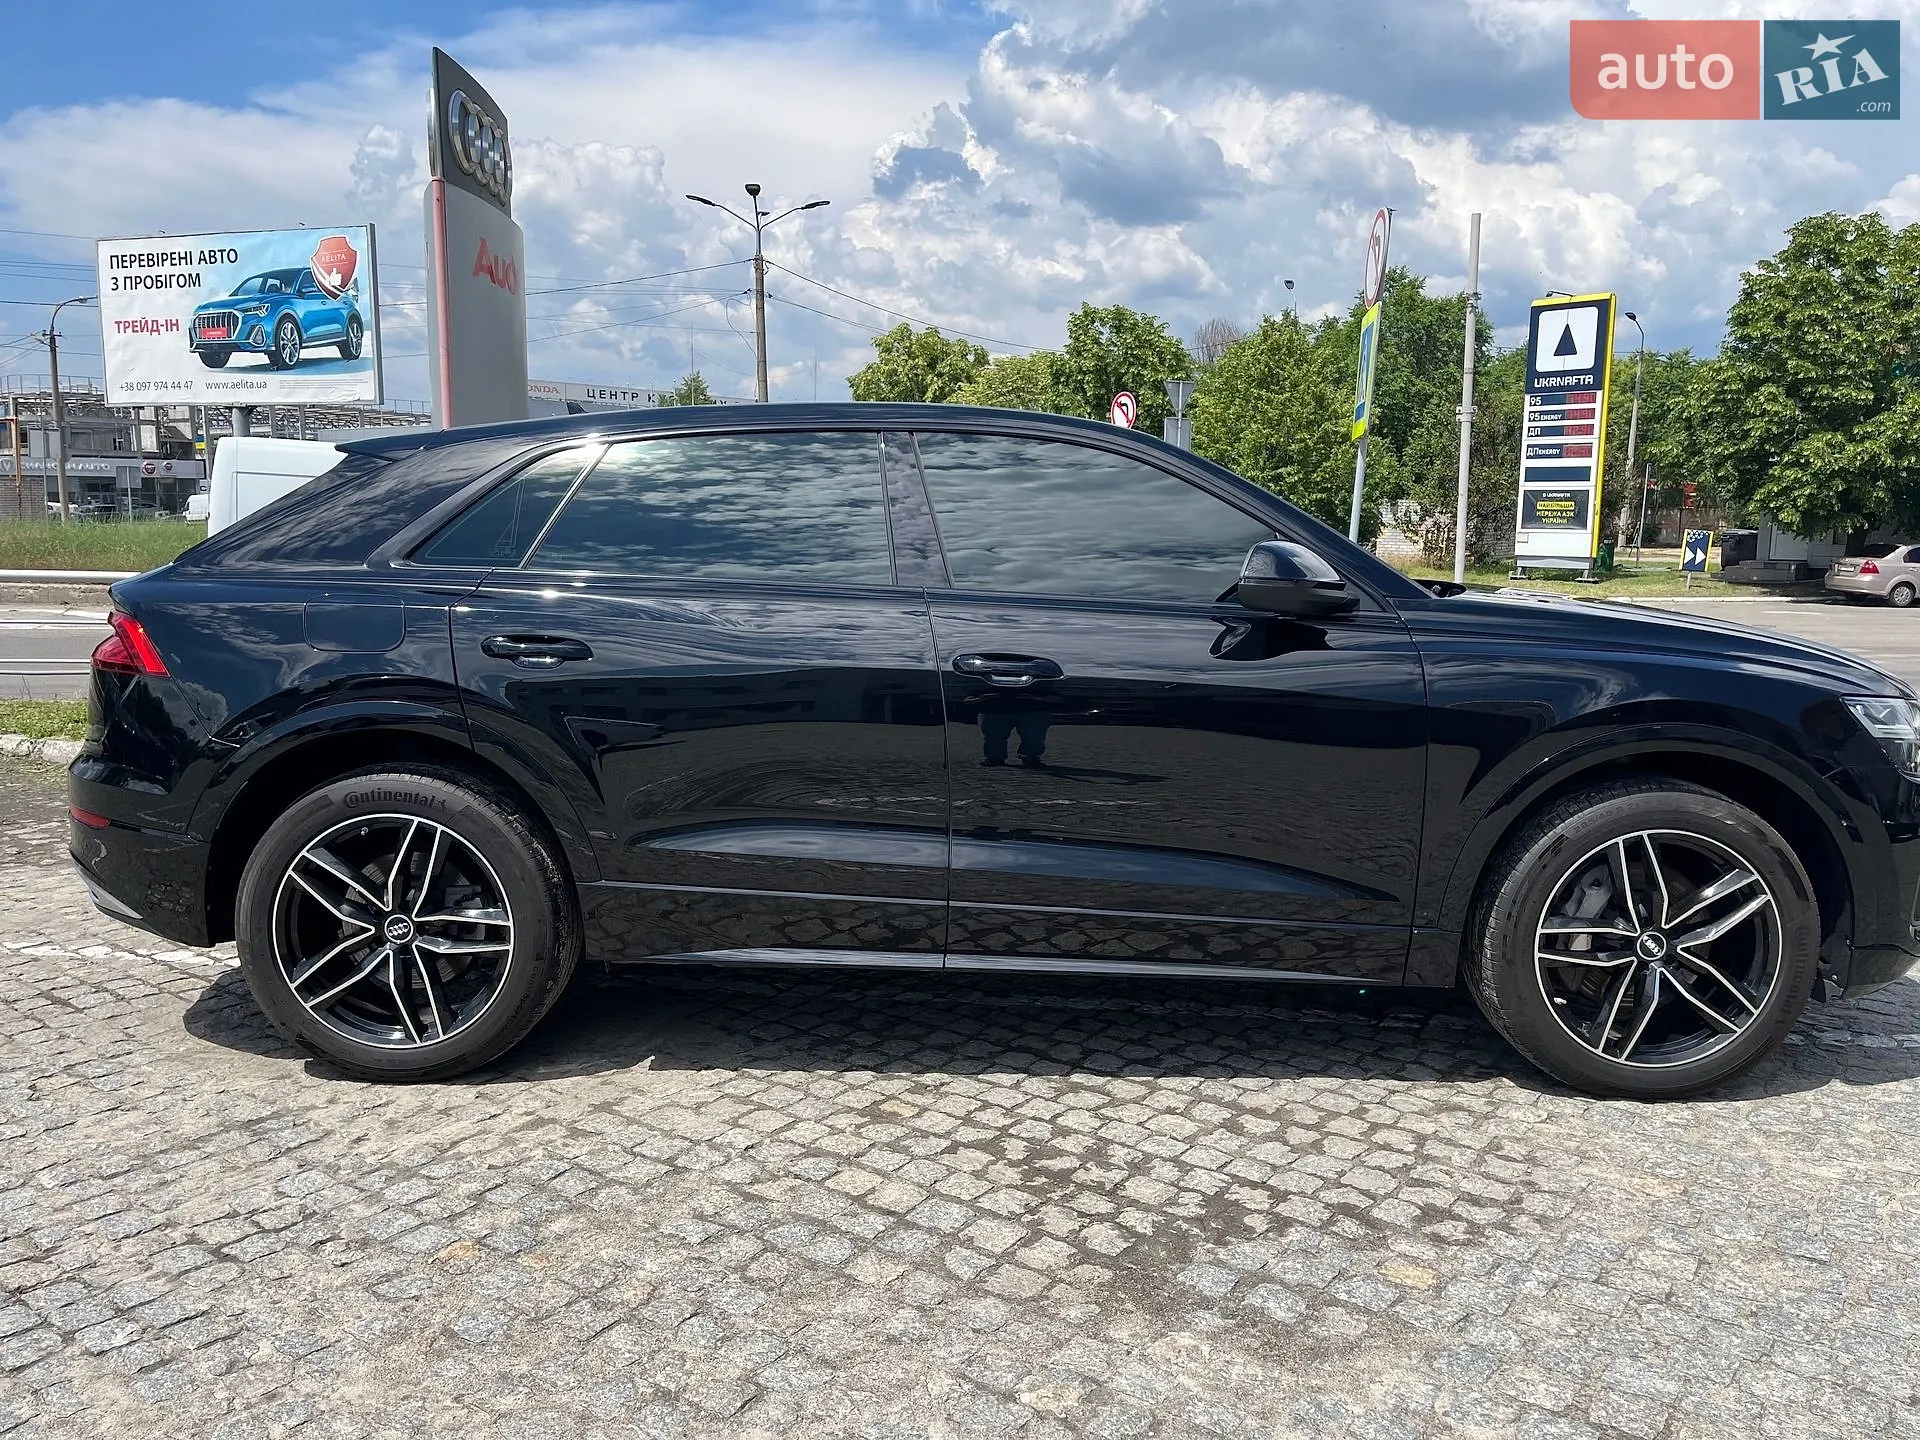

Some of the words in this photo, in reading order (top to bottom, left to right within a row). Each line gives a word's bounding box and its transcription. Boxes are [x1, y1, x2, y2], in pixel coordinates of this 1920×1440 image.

[109, 250, 193, 269] ПЕРЕВІРЕНІ
[197, 248, 239, 265] АВТО
[320, 253, 347, 263] AELITA
[123, 272, 202, 290] ПРОБІГОМ
[114, 316, 180, 335] ТРЕЙД-ІН
[119, 381, 135, 392] +38
[136, 381, 151, 391] 097
[153, 381, 169, 391] 974
[170, 381, 182, 390] 44
[183, 380, 194, 390] 47
[204, 379, 268, 390] www.aelita.ua
[1534, 375, 1594, 388] UKRNAFTA
[527, 385, 560, 394] ONDA
[586, 388, 639, 402] ЦЕНТР
[1530, 396, 1542, 406] 95
[1529, 413, 1540, 421] 95
[1528, 427, 1541, 437] ДП
[343, 787, 436, 808] Continental
